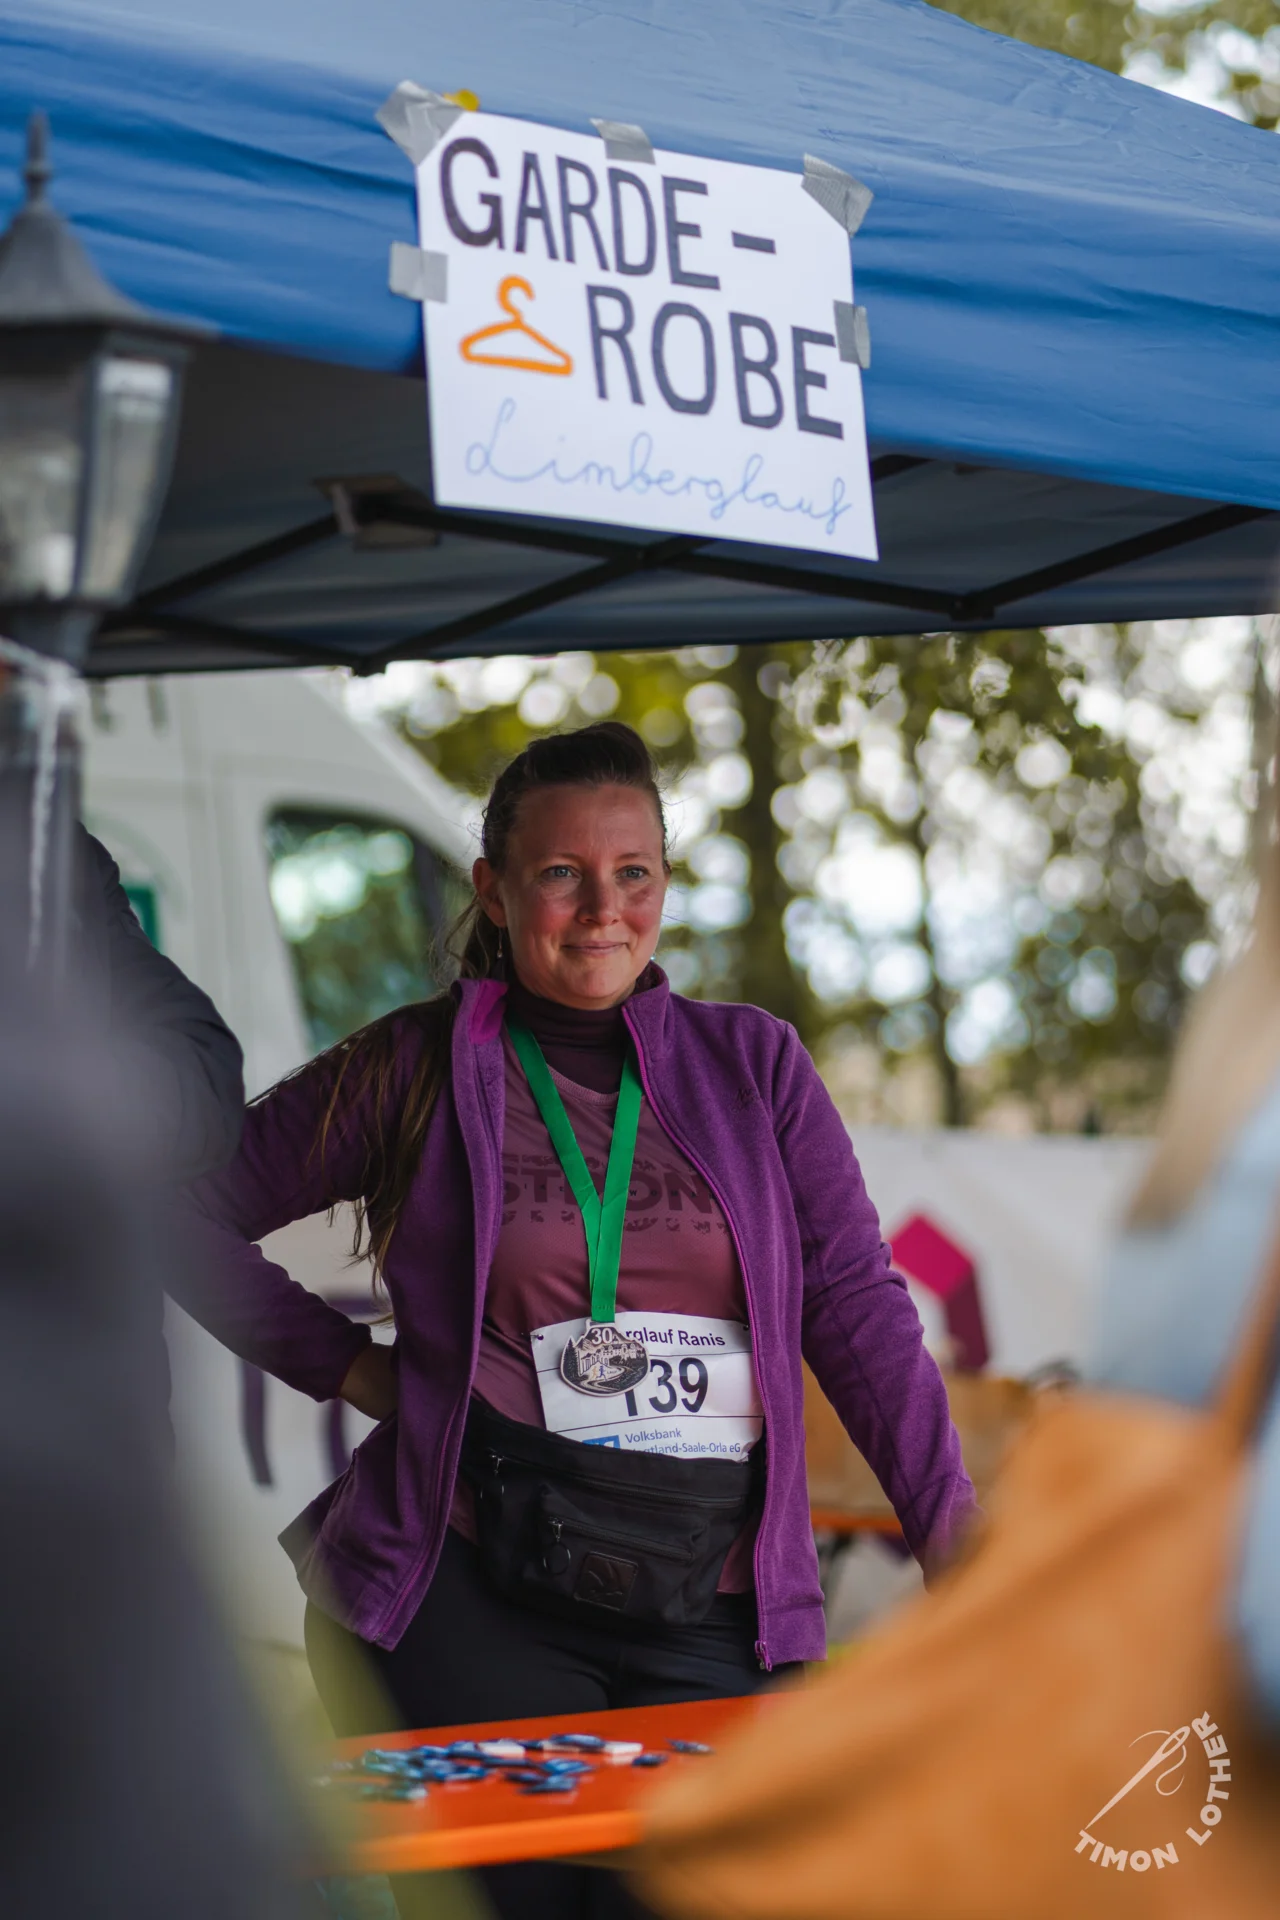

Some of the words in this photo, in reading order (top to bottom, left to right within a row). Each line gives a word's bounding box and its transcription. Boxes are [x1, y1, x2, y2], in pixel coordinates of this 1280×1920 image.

[585, 284, 844, 440] ROBE
[465, 398, 852, 534] Limberglauf
[591, 1327, 613, 1345] 30
[678, 1330, 726, 1346] Ranis
[625, 1428, 682, 1443] Volksbank
[729, 1443, 741, 1453] eG
